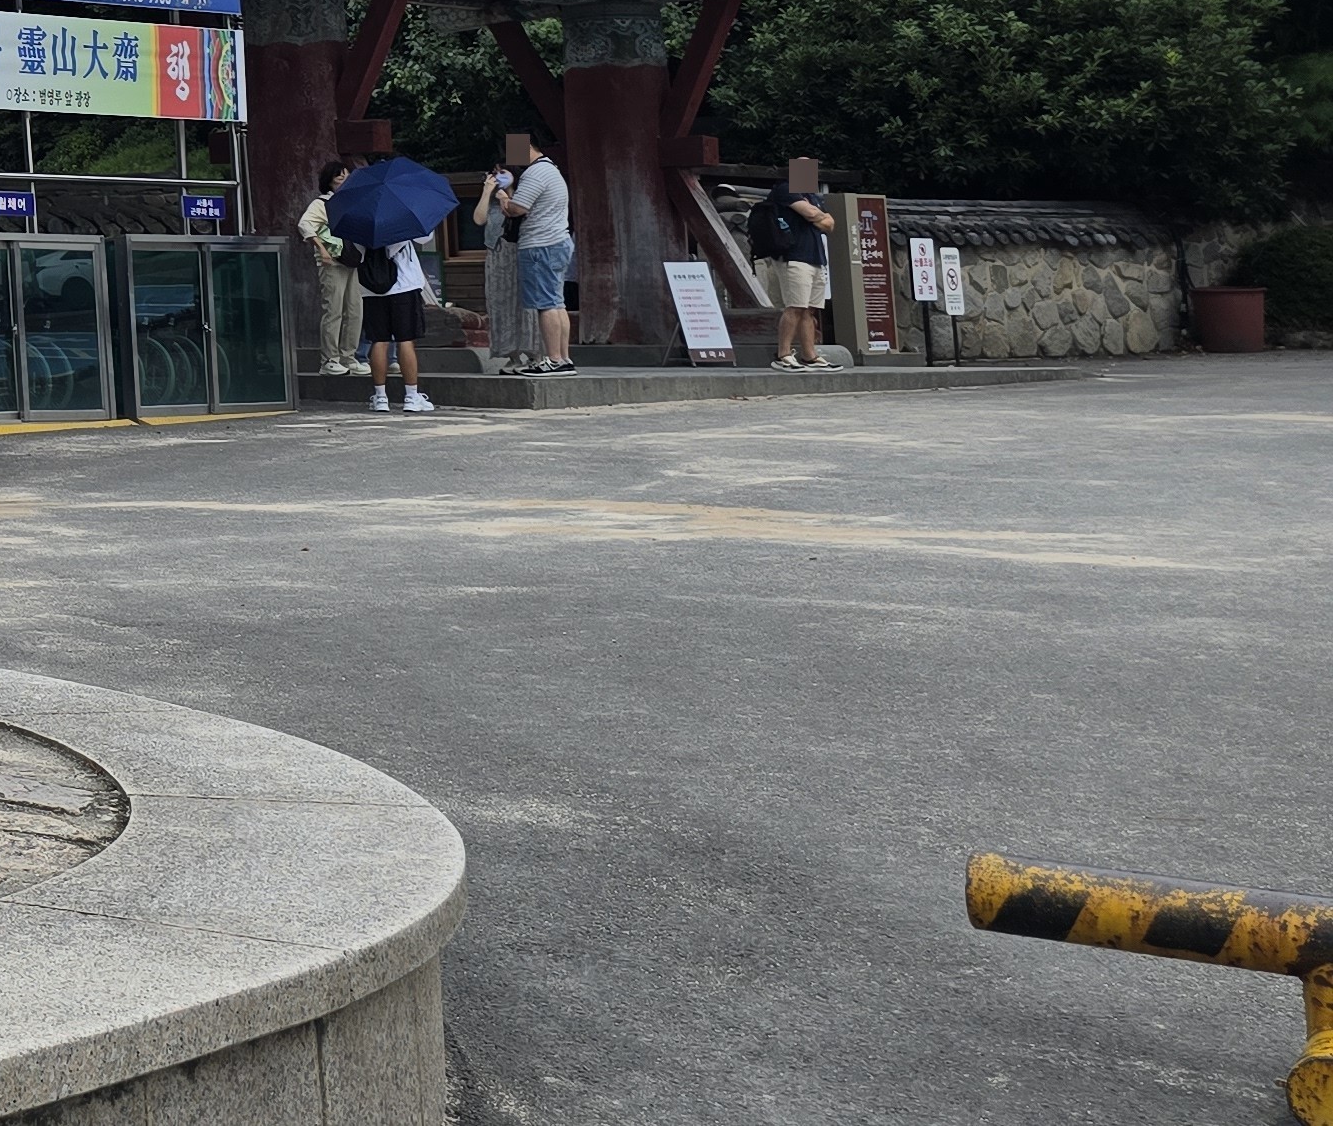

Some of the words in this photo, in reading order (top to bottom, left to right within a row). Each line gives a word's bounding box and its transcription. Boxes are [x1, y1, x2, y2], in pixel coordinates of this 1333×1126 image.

[166, 40, 191, 101] 행
[38, 88, 63, 106] 범영루
[64, 90, 73, 107] 앞
[74, 91, 91, 108] 광장
